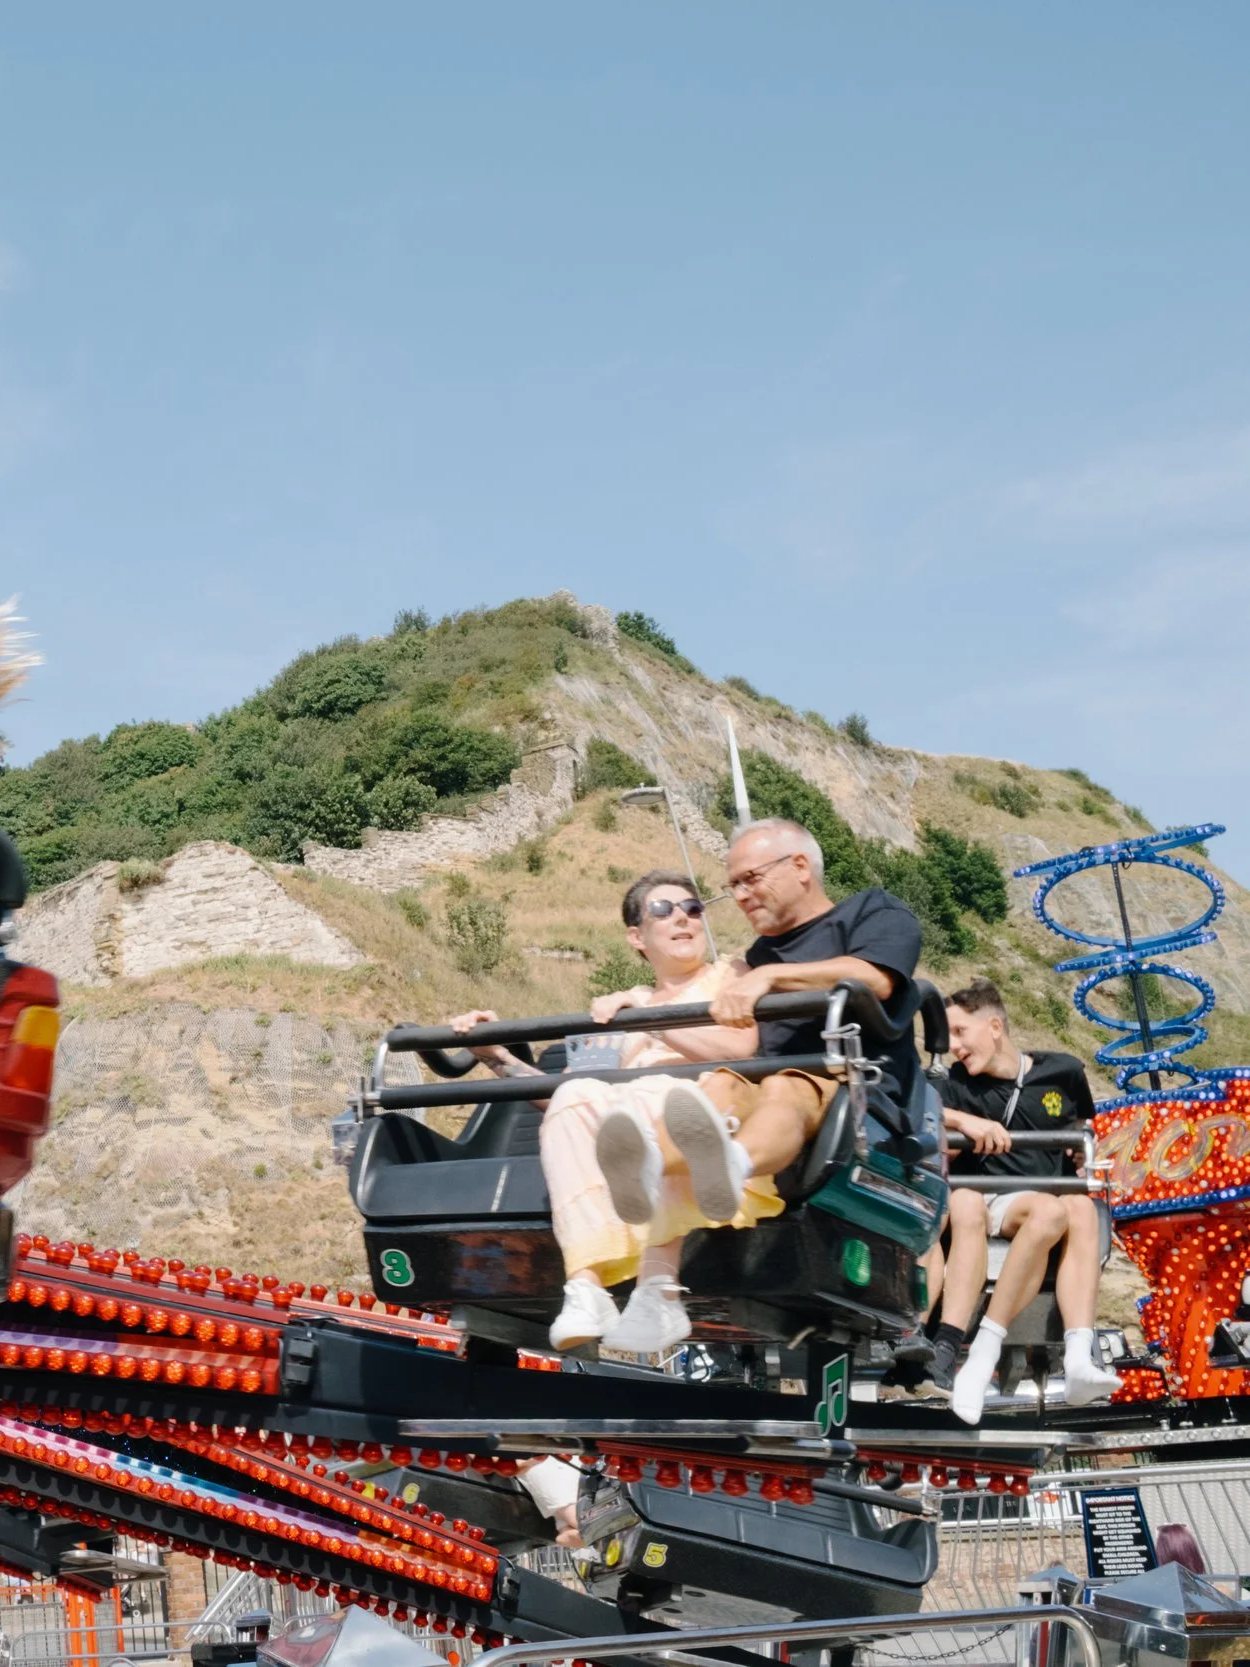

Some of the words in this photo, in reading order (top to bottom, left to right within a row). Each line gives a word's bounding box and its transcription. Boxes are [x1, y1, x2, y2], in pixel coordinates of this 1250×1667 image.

[380, 1249, 415, 1287] 3
[402, 1482, 420, 1504] 6
[642, 1542, 668, 1567] 5
